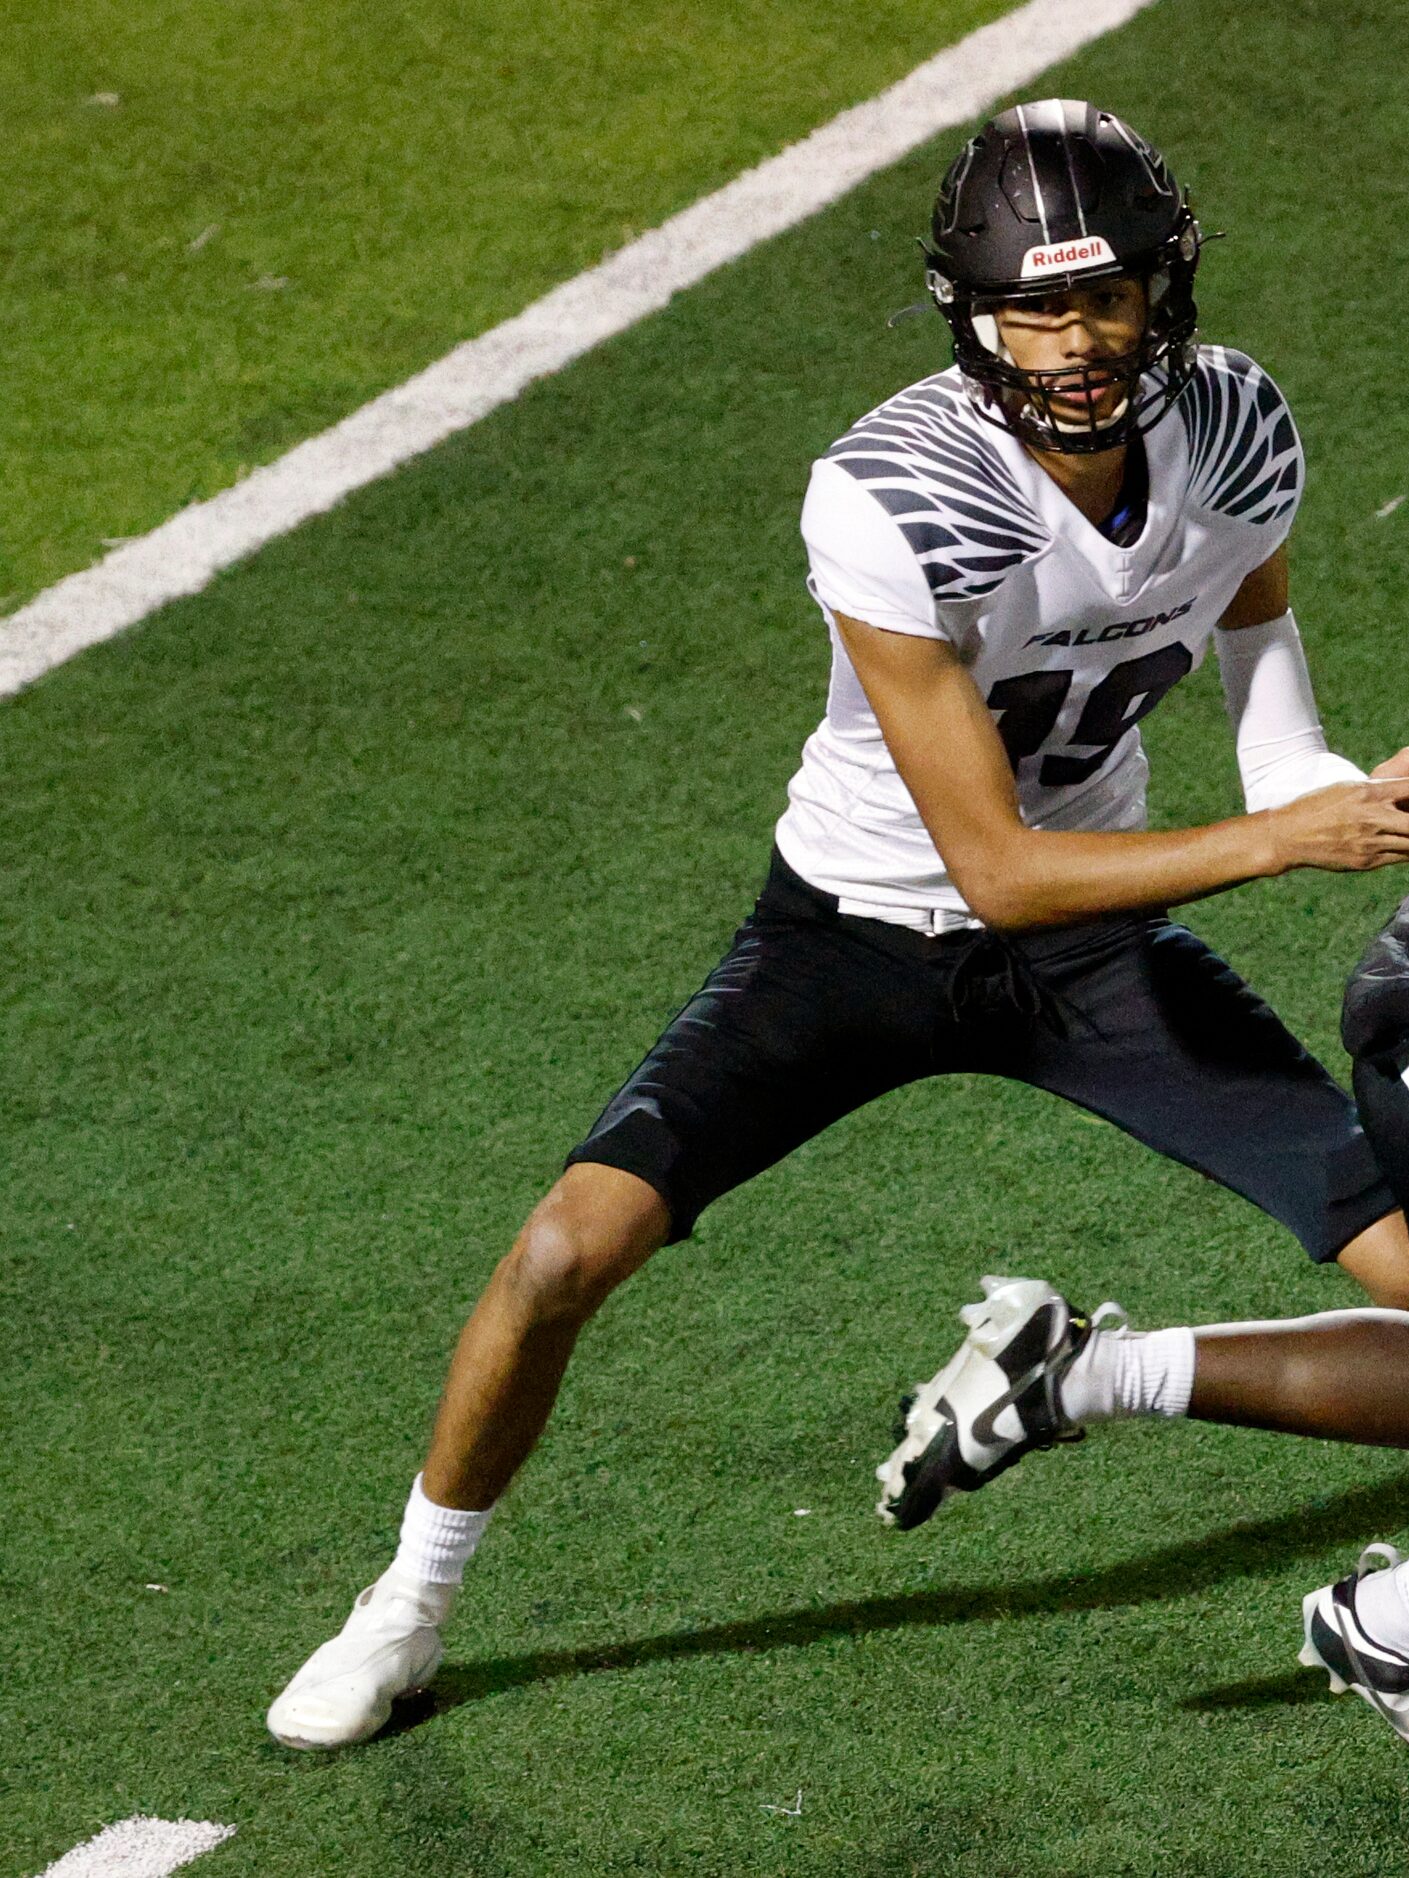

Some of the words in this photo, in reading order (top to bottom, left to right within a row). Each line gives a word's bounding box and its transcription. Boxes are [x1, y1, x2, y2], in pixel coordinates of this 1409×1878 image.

[1032, 241, 1102, 267] Riddell
[1021, 596, 1198, 649] FALCONS
[987, 641, 1193, 787] 19
